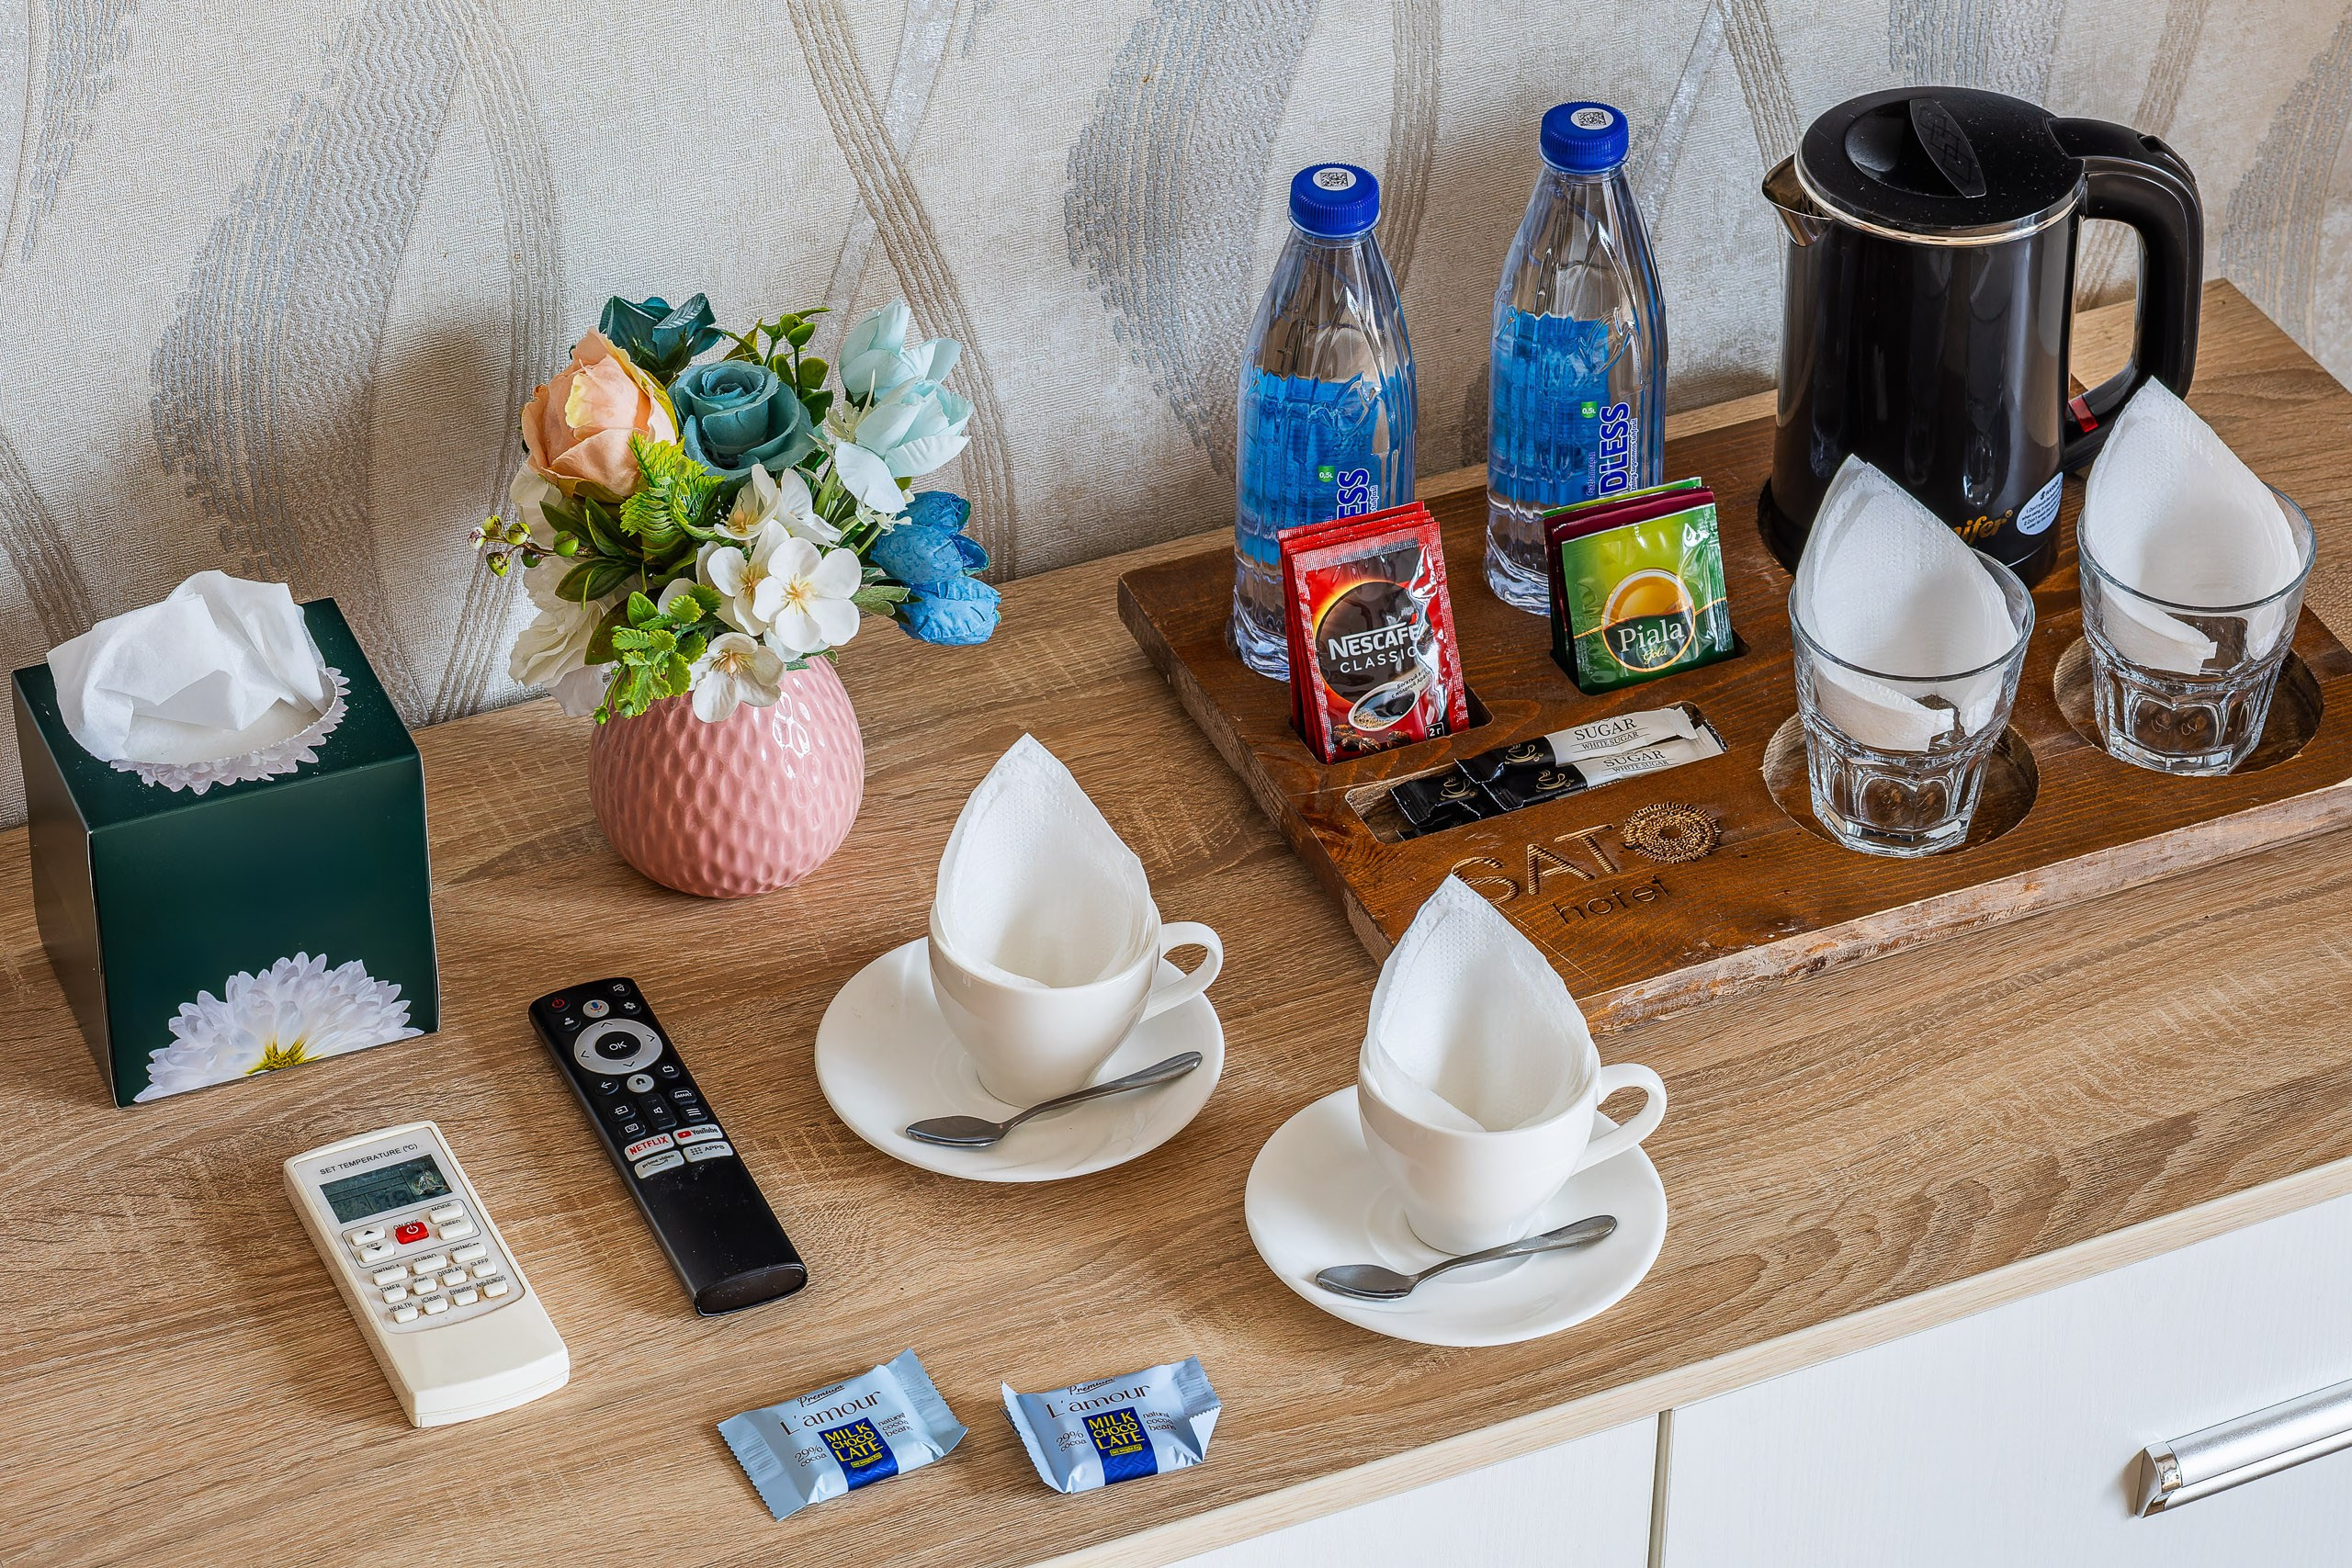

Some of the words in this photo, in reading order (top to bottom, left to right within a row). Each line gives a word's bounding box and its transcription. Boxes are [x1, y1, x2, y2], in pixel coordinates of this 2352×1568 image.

[1599, 401, 1631, 496] DLESS
[1337, 468, 1370, 520] ESS
[1617, 619, 1685, 653] Piala
[1340, 646, 1417, 673] CLASSIC
[1641, 645, 1669, 665] Gold
[1574, 717, 1637, 741] SUGAR
[1581, 740, 1609, 750] WHITE
[1610, 731, 1639, 743] SUGAR
[1603, 750, 1666, 768] SUGAR
[1612, 763, 1638, 773] WHITE
[1639, 760, 1669, 769] SUGAR
[1552, 874, 1670, 925] hotel
[608, 1041, 628, 1051] OK
[691, 1126, 718, 1136] YouTube
[628, 1135, 669, 1156] NETFLIX
[704, 1144, 725, 1152] APPS
[320, 1165, 336, 1175] SET
[337, 1148, 402, 1170] TEMPERATURE
[641, 1158, 659, 1168] prime
[659, 1154, 675, 1163] video
[437, 1266, 463, 1278] DISPLAY
[379, 1283, 401, 1293] TIMER
[389, 1301, 413, 1314] HEALTH
[421, 1294, 442, 1304] iClean
[1066, 1377, 1116, 1395] Premium
[797, 1383, 845, 1408] Premium
[877, 1412, 906, 1427] natural
[1088, 1411, 1136, 1430] MILK
[1142, 1410, 1170, 1419] natural
[824, 1421, 871, 1443] MILK
[1057, 1430, 1084, 1447] 29%
[1092, 1422, 1138, 1438] CHOCO
[831, 1430, 875, 1450] CHOCO
[1060, 1438, 1088, 1452] cocoa
[1095, 1429, 1146, 1450] LATE
[794, 1445, 823, 1462] 29%
[834, 1438, 884, 1462] LATE
[800, 1452, 828, 1467] cocoa
